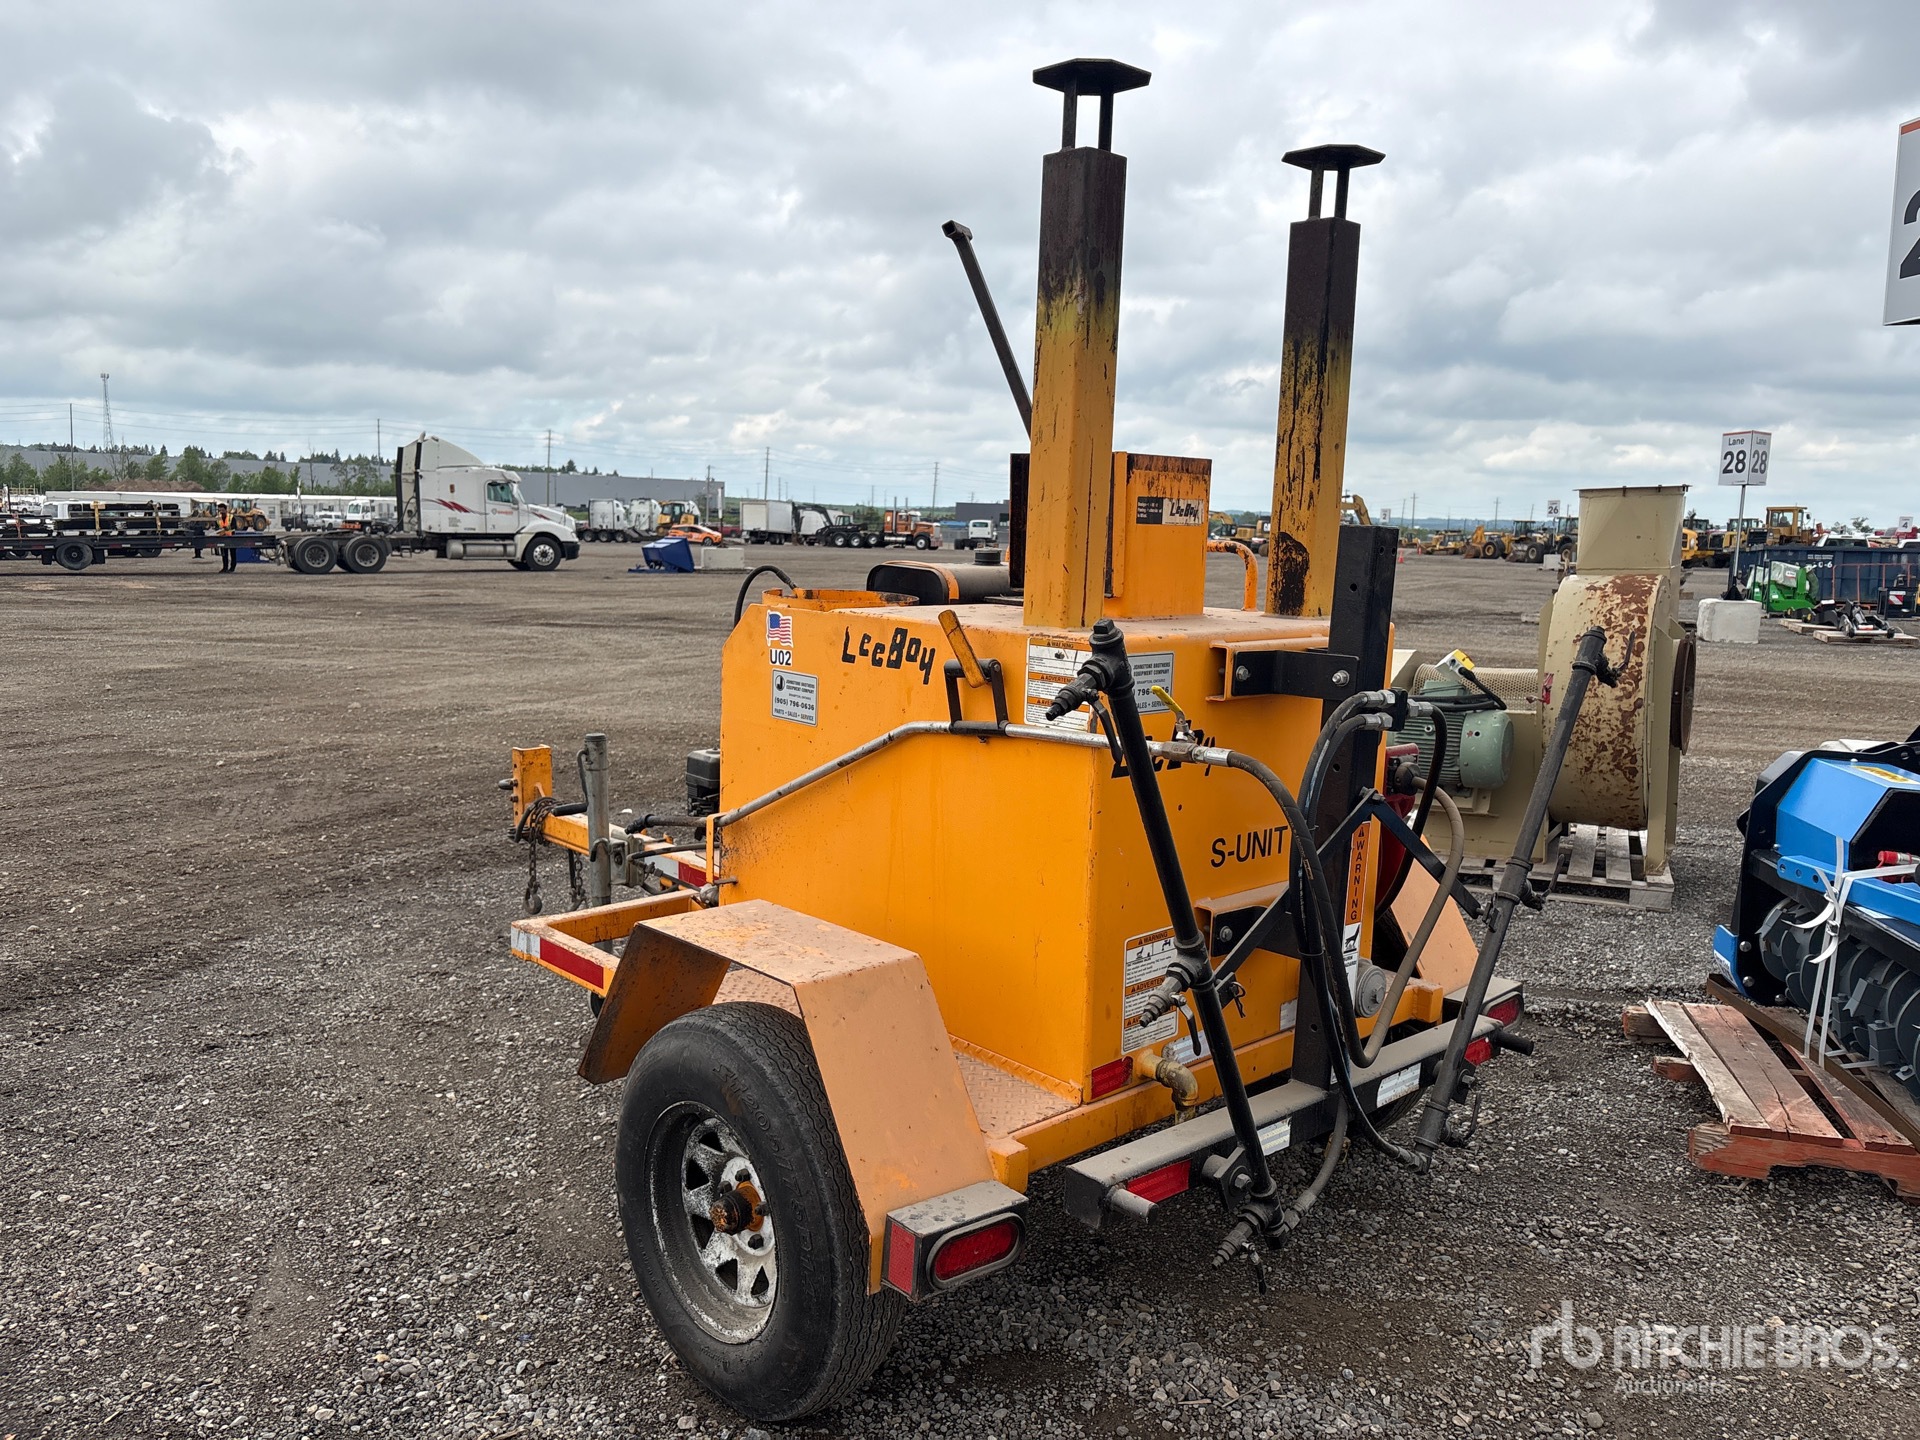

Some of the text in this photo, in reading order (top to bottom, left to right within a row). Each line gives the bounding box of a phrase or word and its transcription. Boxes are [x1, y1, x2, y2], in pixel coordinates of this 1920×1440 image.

[1728, 437, 1745, 446] Lane
[1755, 437, 1767, 445] Lane
[1722, 450, 1746, 474] 28
[1751, 450, 1767, 474] 28
[1548, 505, 1559, 514] 26
[1902, 521, 1908, 529] 4
[770, 649, 791, 666] U02
[841, 626, 936, 685] LeeBoy
[774, 696, 789, 706] (905)
[1210, 825, 1288, 868] S-UNIT
[1350, 840, 1365, 921] WARNING
[1143, 931, 1168, 944] WARNING
